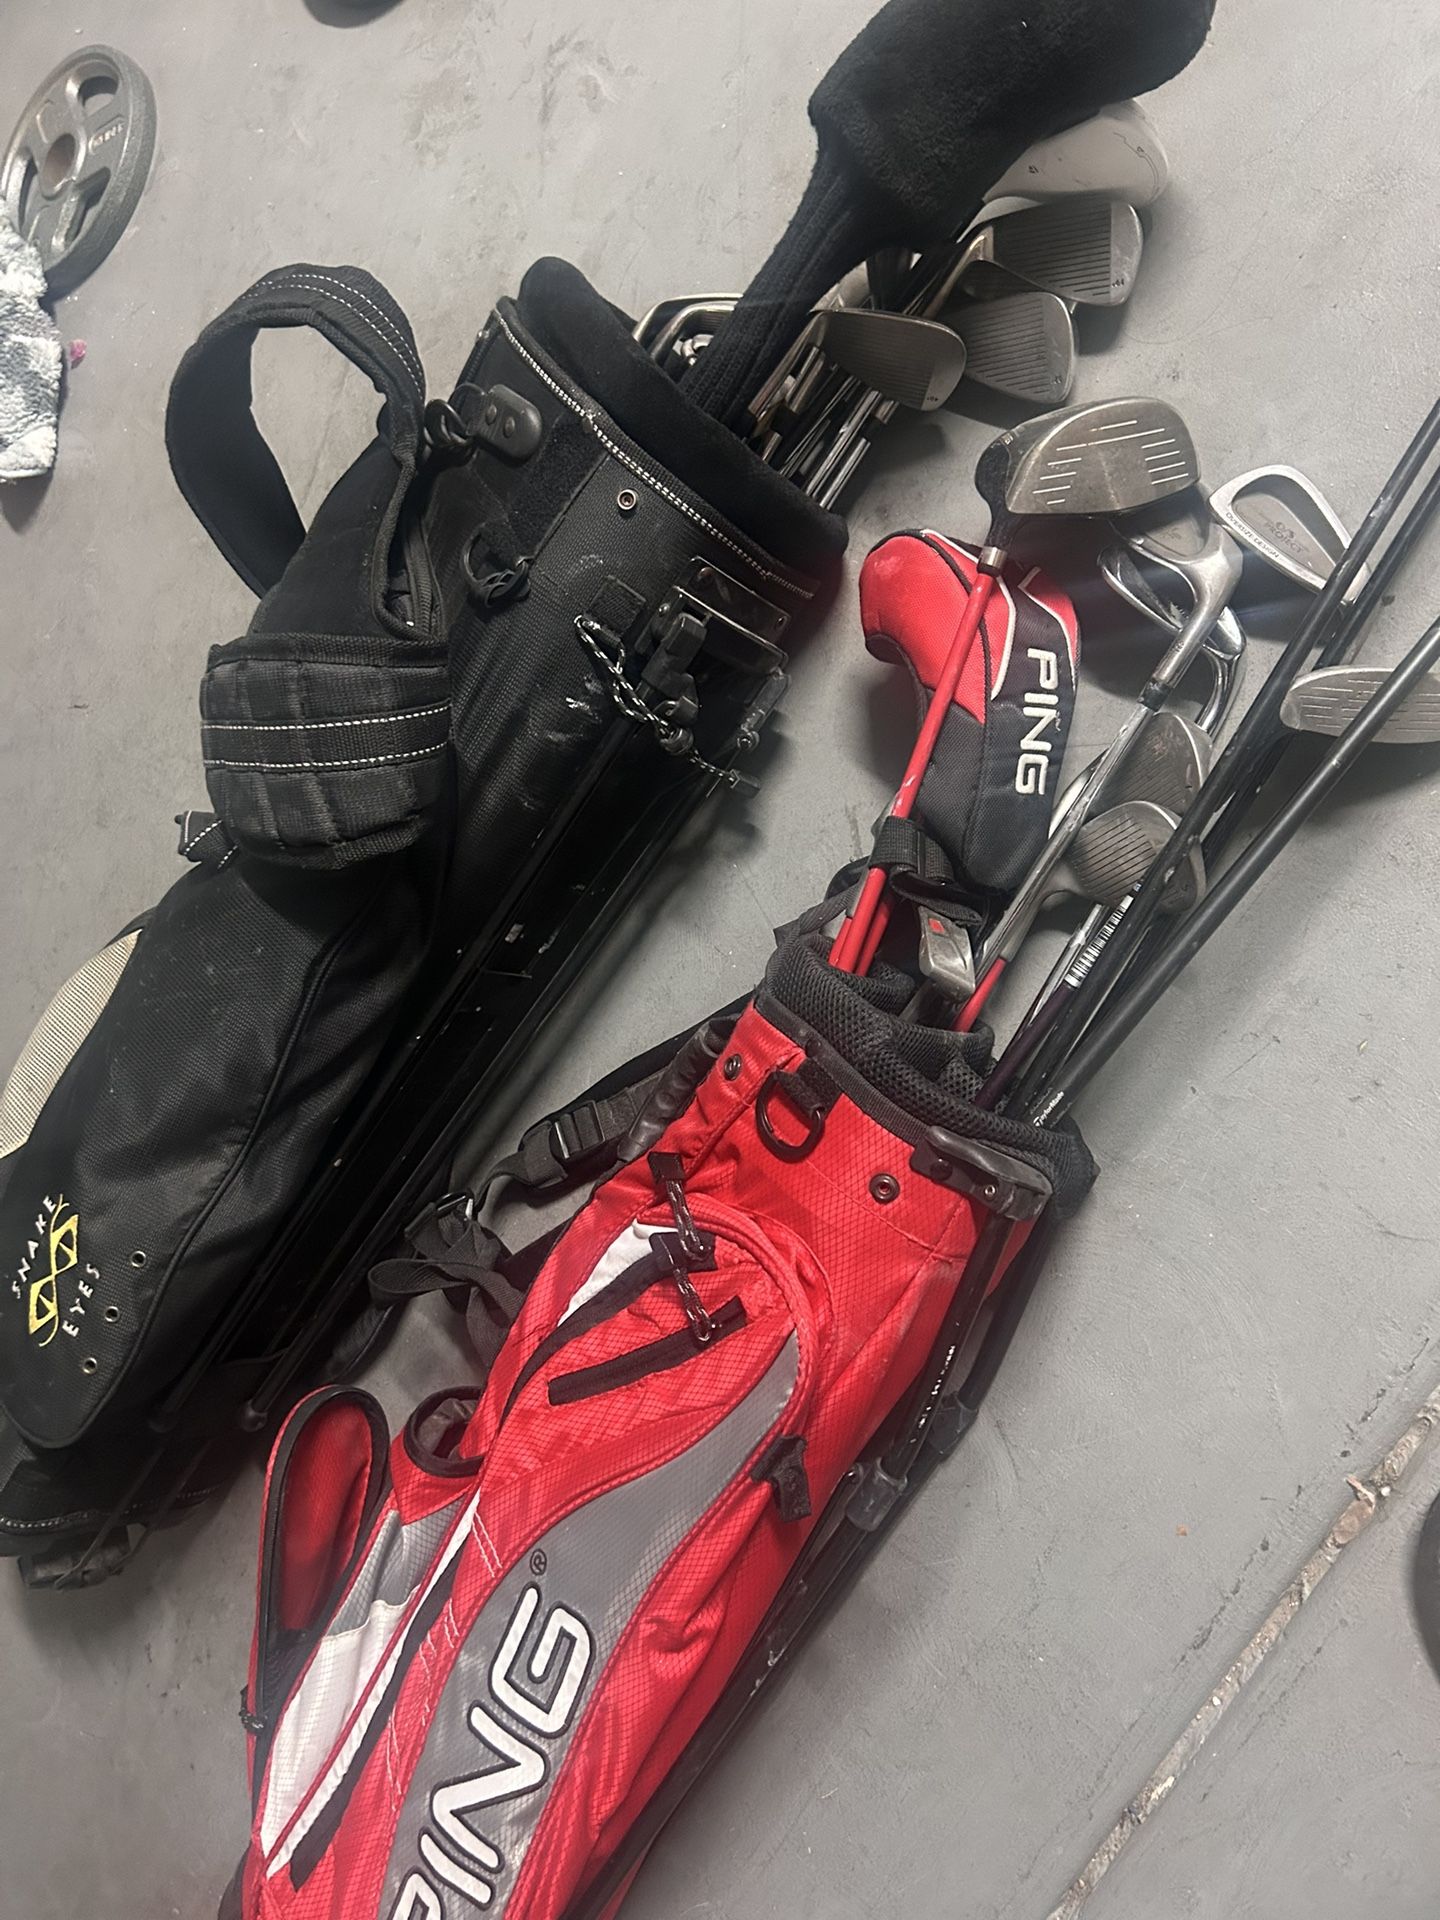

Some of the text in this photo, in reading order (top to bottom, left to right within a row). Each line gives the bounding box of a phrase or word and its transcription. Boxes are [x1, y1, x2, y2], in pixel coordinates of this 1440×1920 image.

[1015, 647, 1059, 796] PING
[12, 1196, 56, 1299] SNAKE
[62, 1263, 100, 1338] EYES
